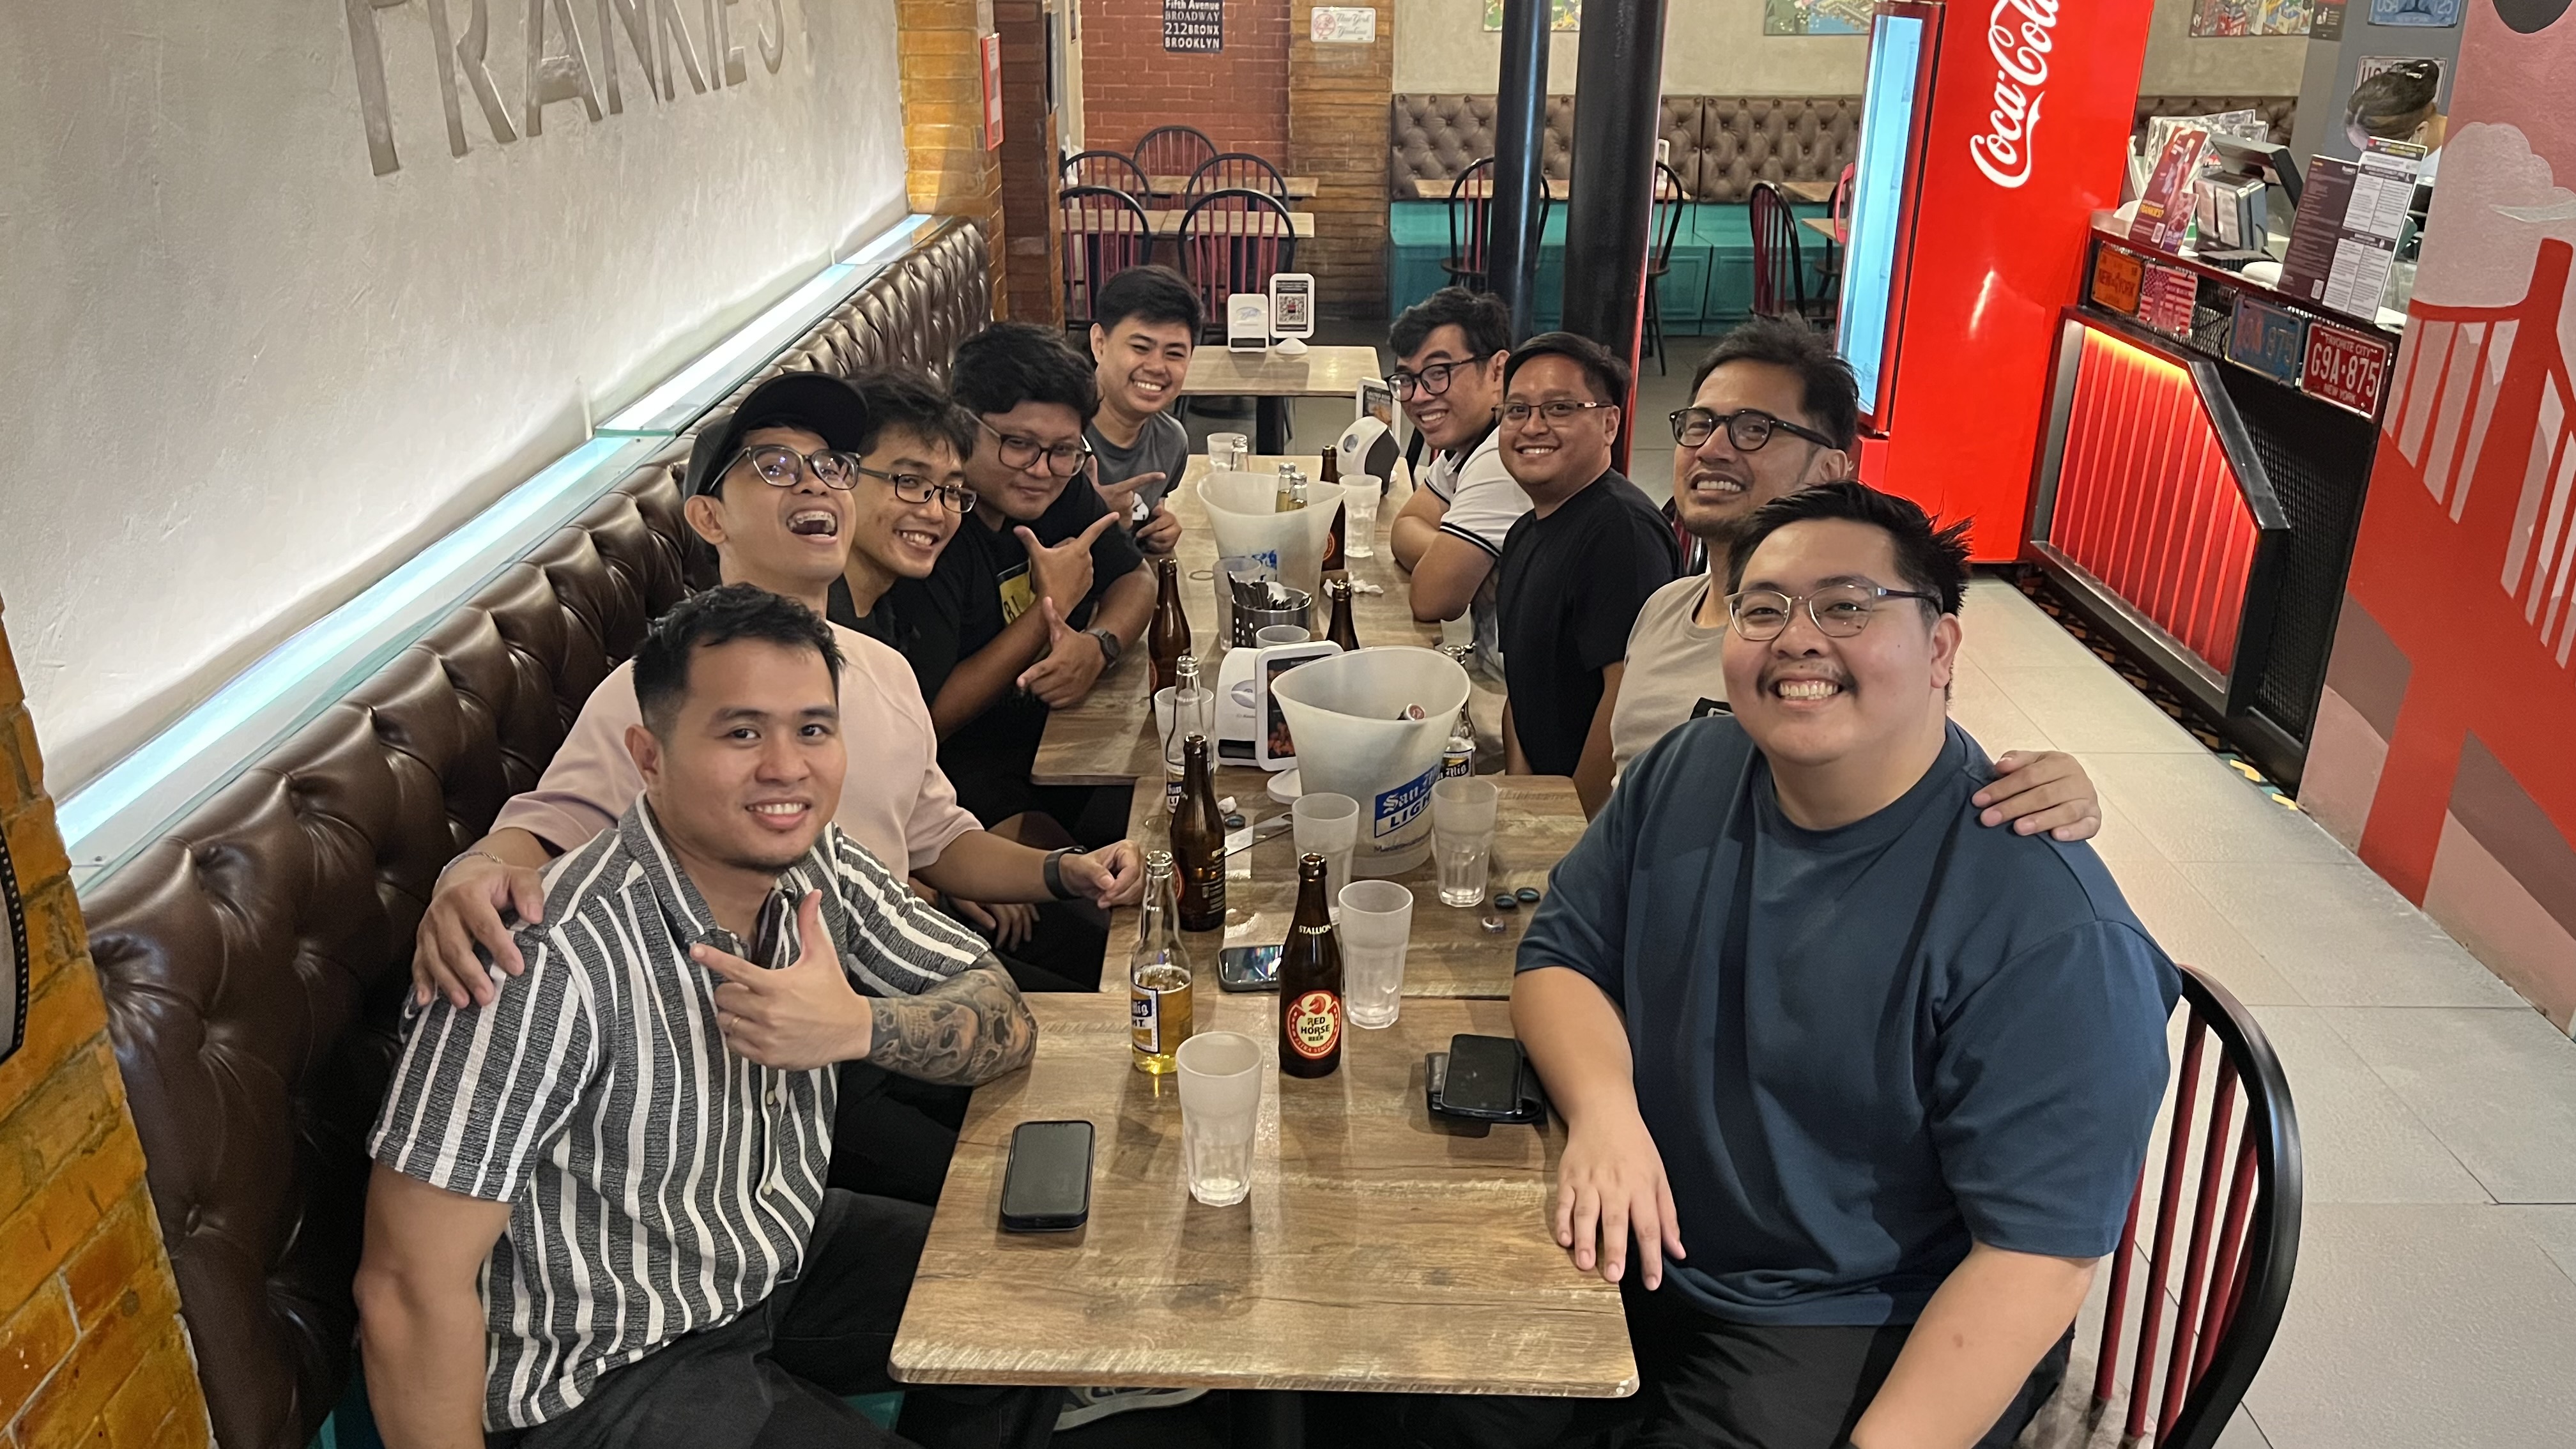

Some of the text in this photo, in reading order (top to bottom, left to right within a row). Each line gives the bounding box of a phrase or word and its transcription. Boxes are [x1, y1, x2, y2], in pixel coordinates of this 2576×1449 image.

[1165, 0, 1220, 10] Fifth Avenue
[1165, 10, 1220, 22] BROADWAY
[1165, 36, 1220, 49] BROOKLYN
[1383, 785, 1419, 815] San
[1390, 790, 1432, 828] LIGH
[1307, 1016, 1326, 1027] RED
[1301, 1024, 1330, 1036] HORSE
